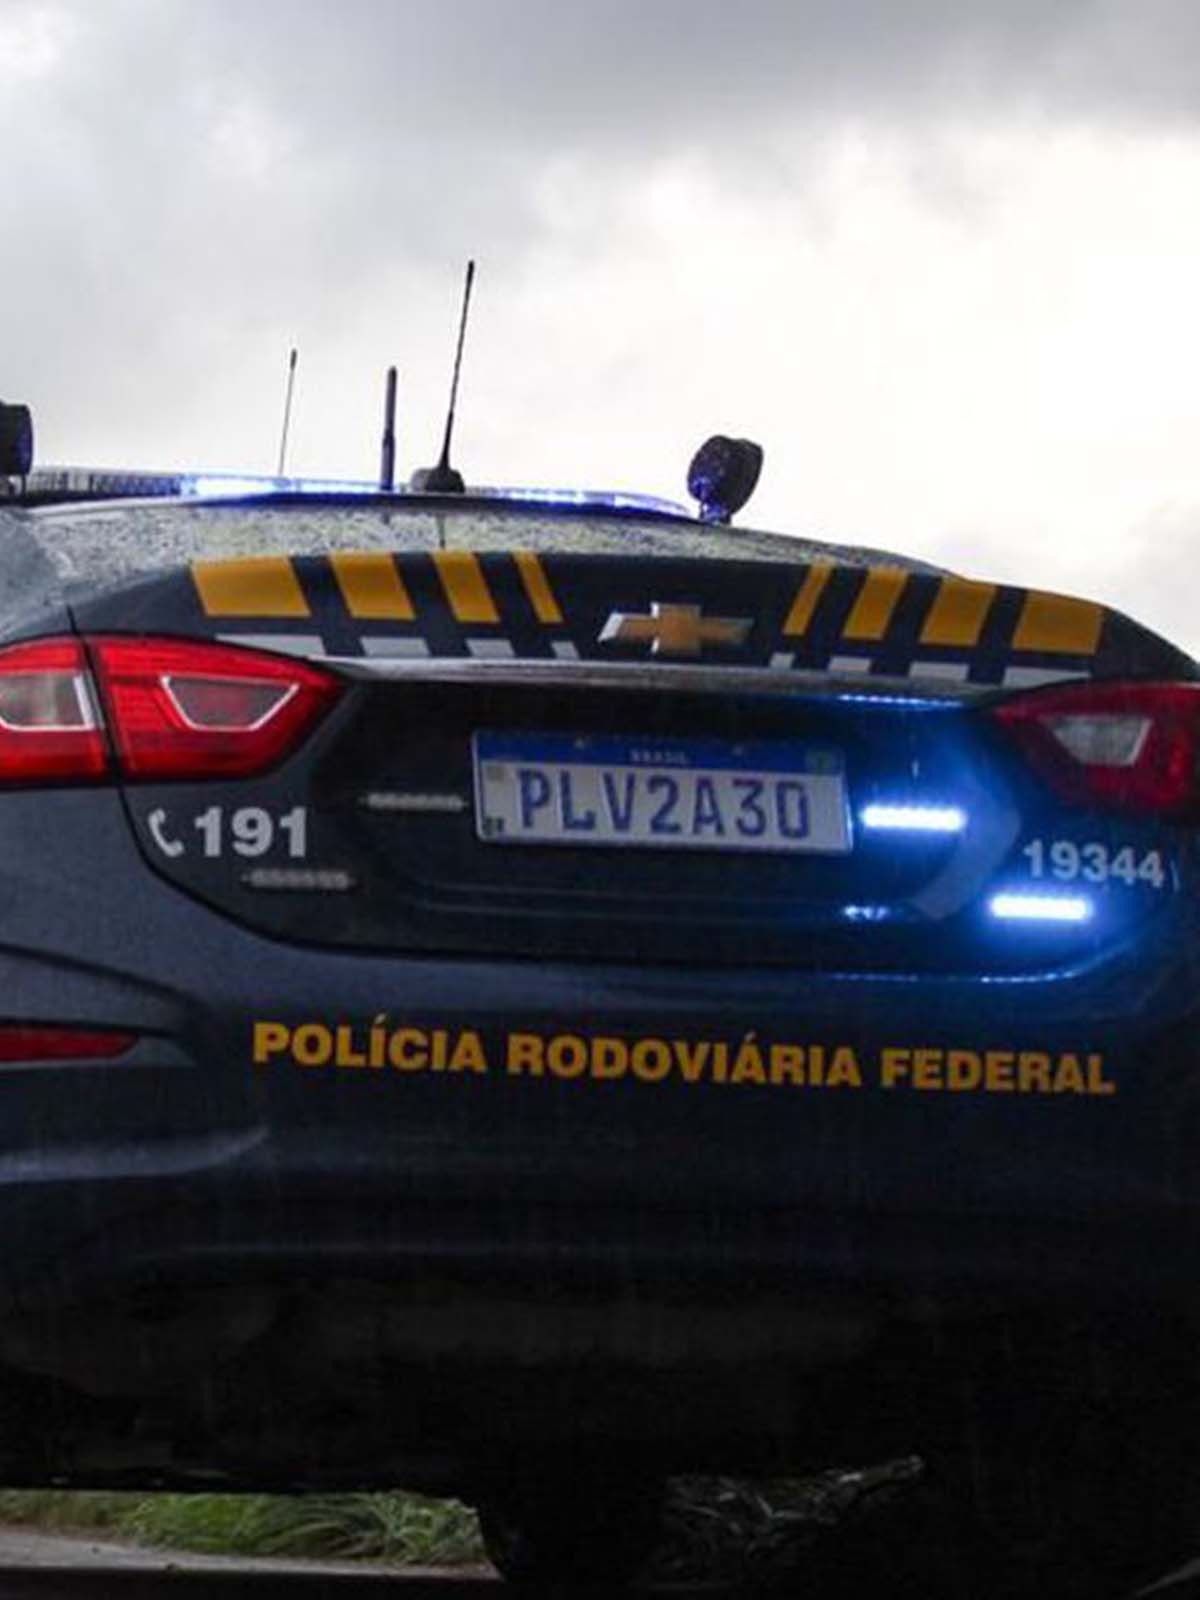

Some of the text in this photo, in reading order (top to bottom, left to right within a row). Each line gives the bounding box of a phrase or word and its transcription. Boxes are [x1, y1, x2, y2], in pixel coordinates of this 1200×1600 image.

[629, 749, 688, 764] BRASIL
[516, 768, 810, 840] PLV2A30
[194, 806, 307, 857] 191
[1023, 839, 1165, 888] 19344
[253, 1013, 1116, 1095] POLÍCIA RODOVIÁRIA FEDERAL
